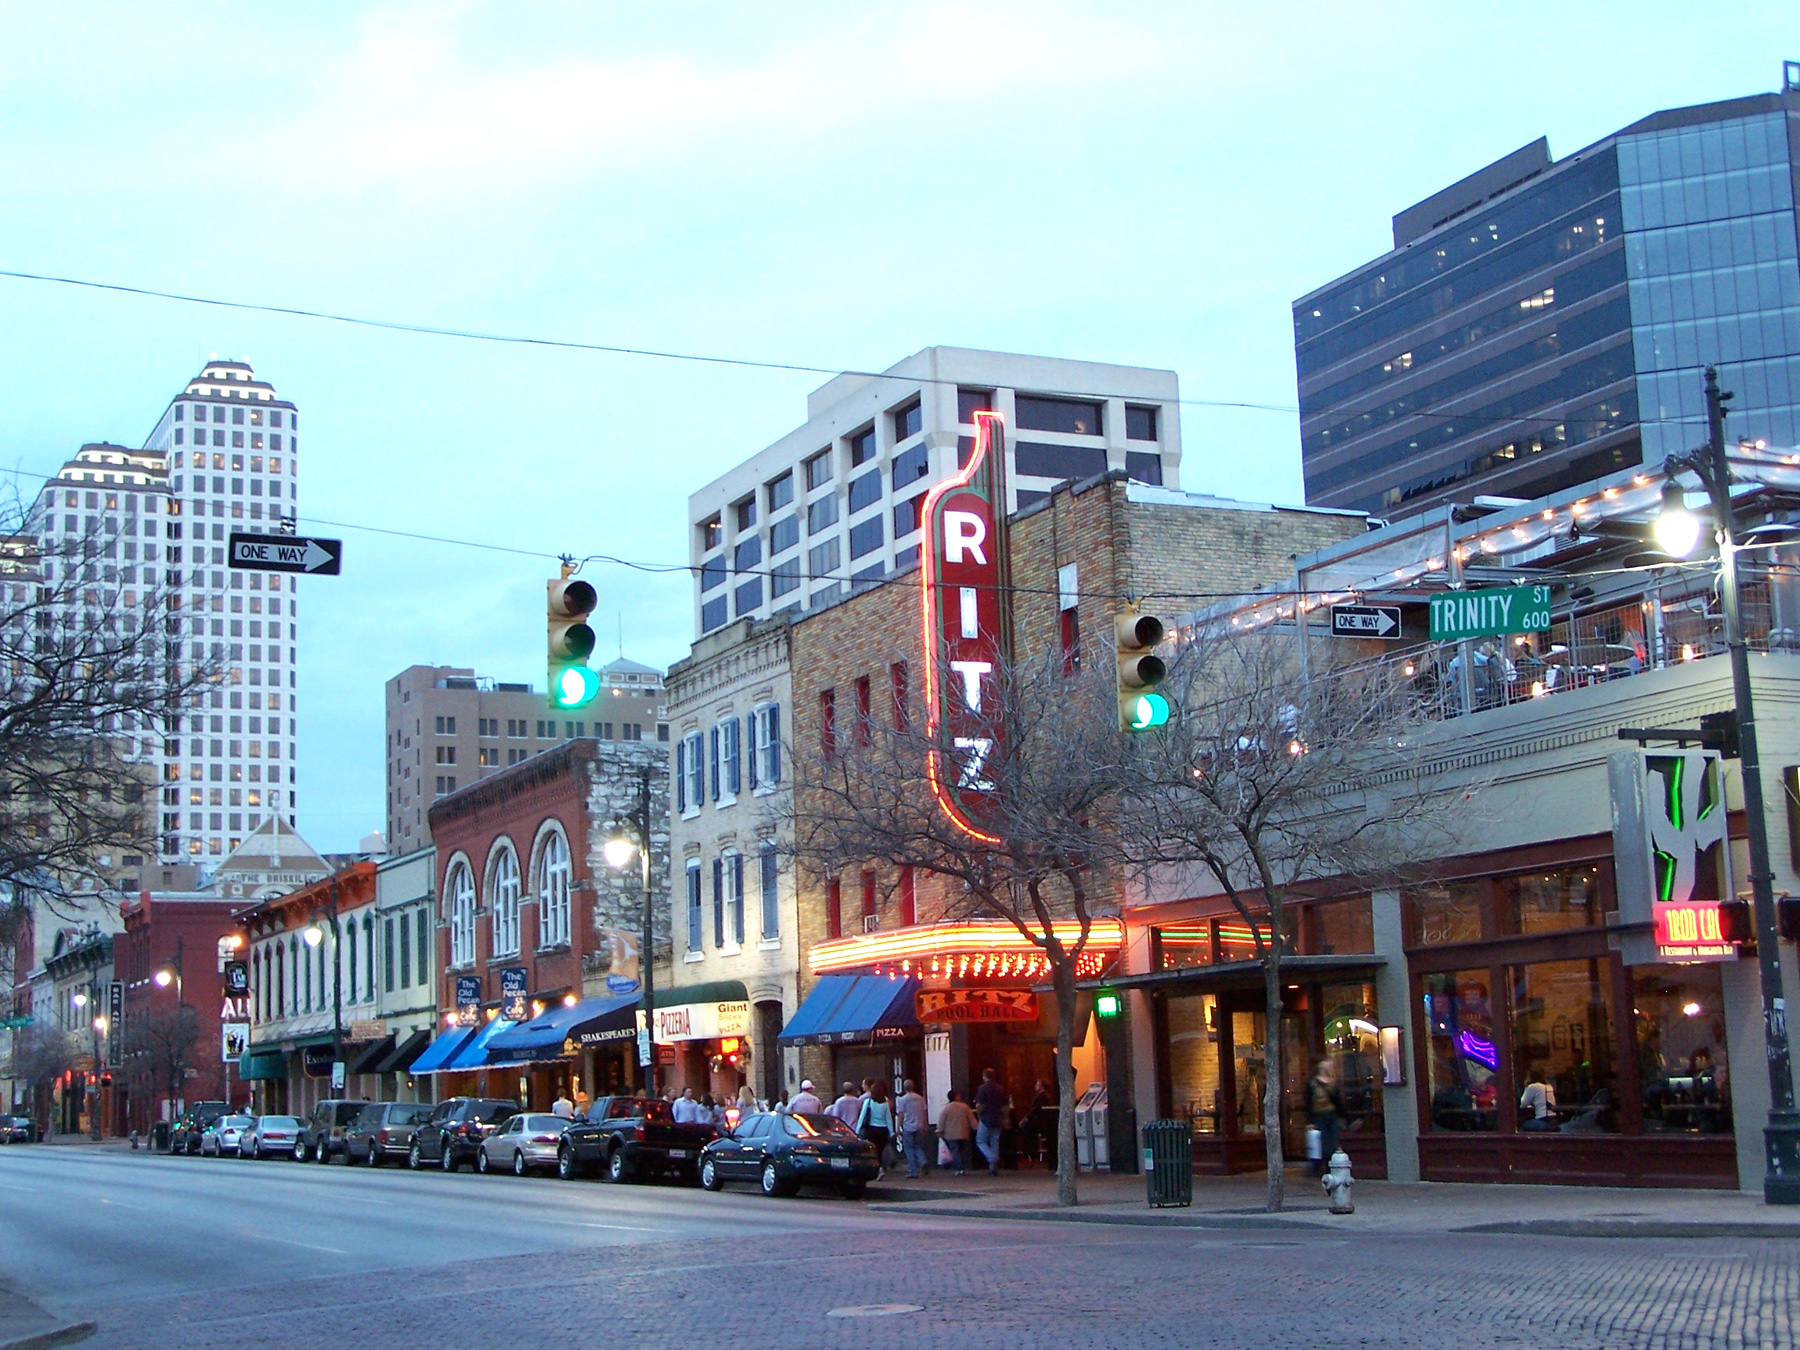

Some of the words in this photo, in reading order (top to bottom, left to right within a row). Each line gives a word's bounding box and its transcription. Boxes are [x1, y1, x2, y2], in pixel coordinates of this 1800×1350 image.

[241, 545, 268, 559] ONE
[278, 547, 307, 562] WAY
[1533, 586, 1549, 604] ST
[1339, 616, 1356, 628] ONE
[1361, 617, 1380, 628] WAY
[1431, 594, 1513, 633] TRINITY
[1522, 611, 1549, 629] 600
[943, 510, 996, 791] RITZ
[1666, 908, 1698, 941] IRON
[502, 990, 527, 998] Pecan
[503, 982, 519, 990] Old
[717, 1003, 748, 1013] Giant
[919, 990, 1032, 1018] RITZ
[936, 1006, 974, 1019] POOL
[980, 1006, 1019, 1018] HALL
[660, 1007, 692, 1039] PIZZERIA
[719, 1022, 742, 1035] PIZZA
[876, 1027, 905, 1037] PIZZA
